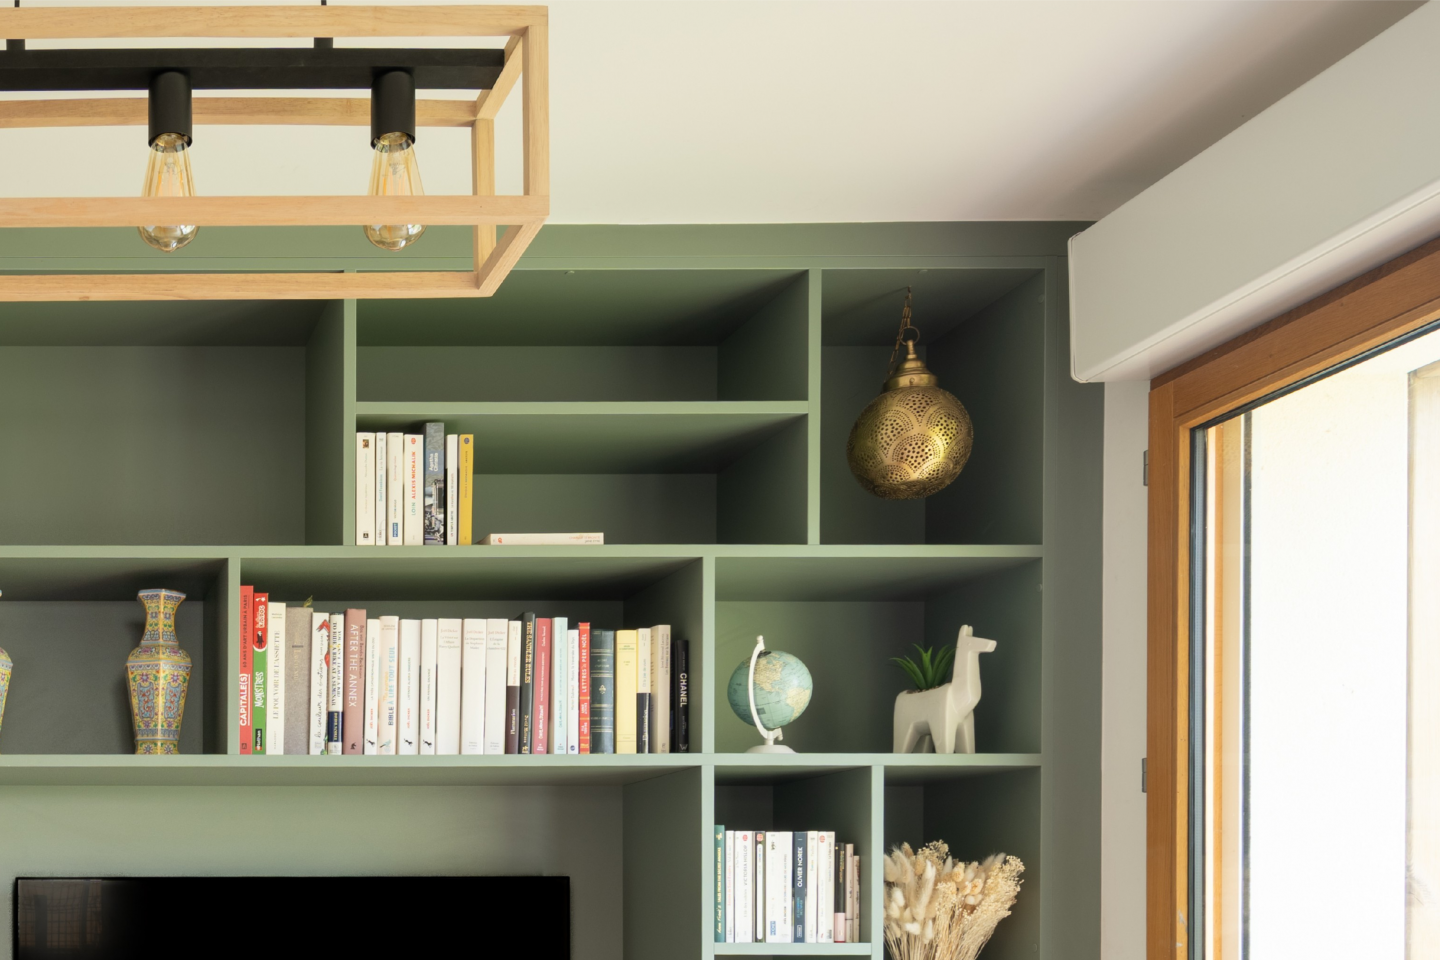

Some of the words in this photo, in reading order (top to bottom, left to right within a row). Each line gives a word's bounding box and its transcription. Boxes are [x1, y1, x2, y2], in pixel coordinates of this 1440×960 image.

[350, 624, 359, 652] AFTER
[349, 654, 358, 671] THE
[240, 674, 249, 726] CAPITALE(S)
[348, 674, 357, 707] ANNEX
